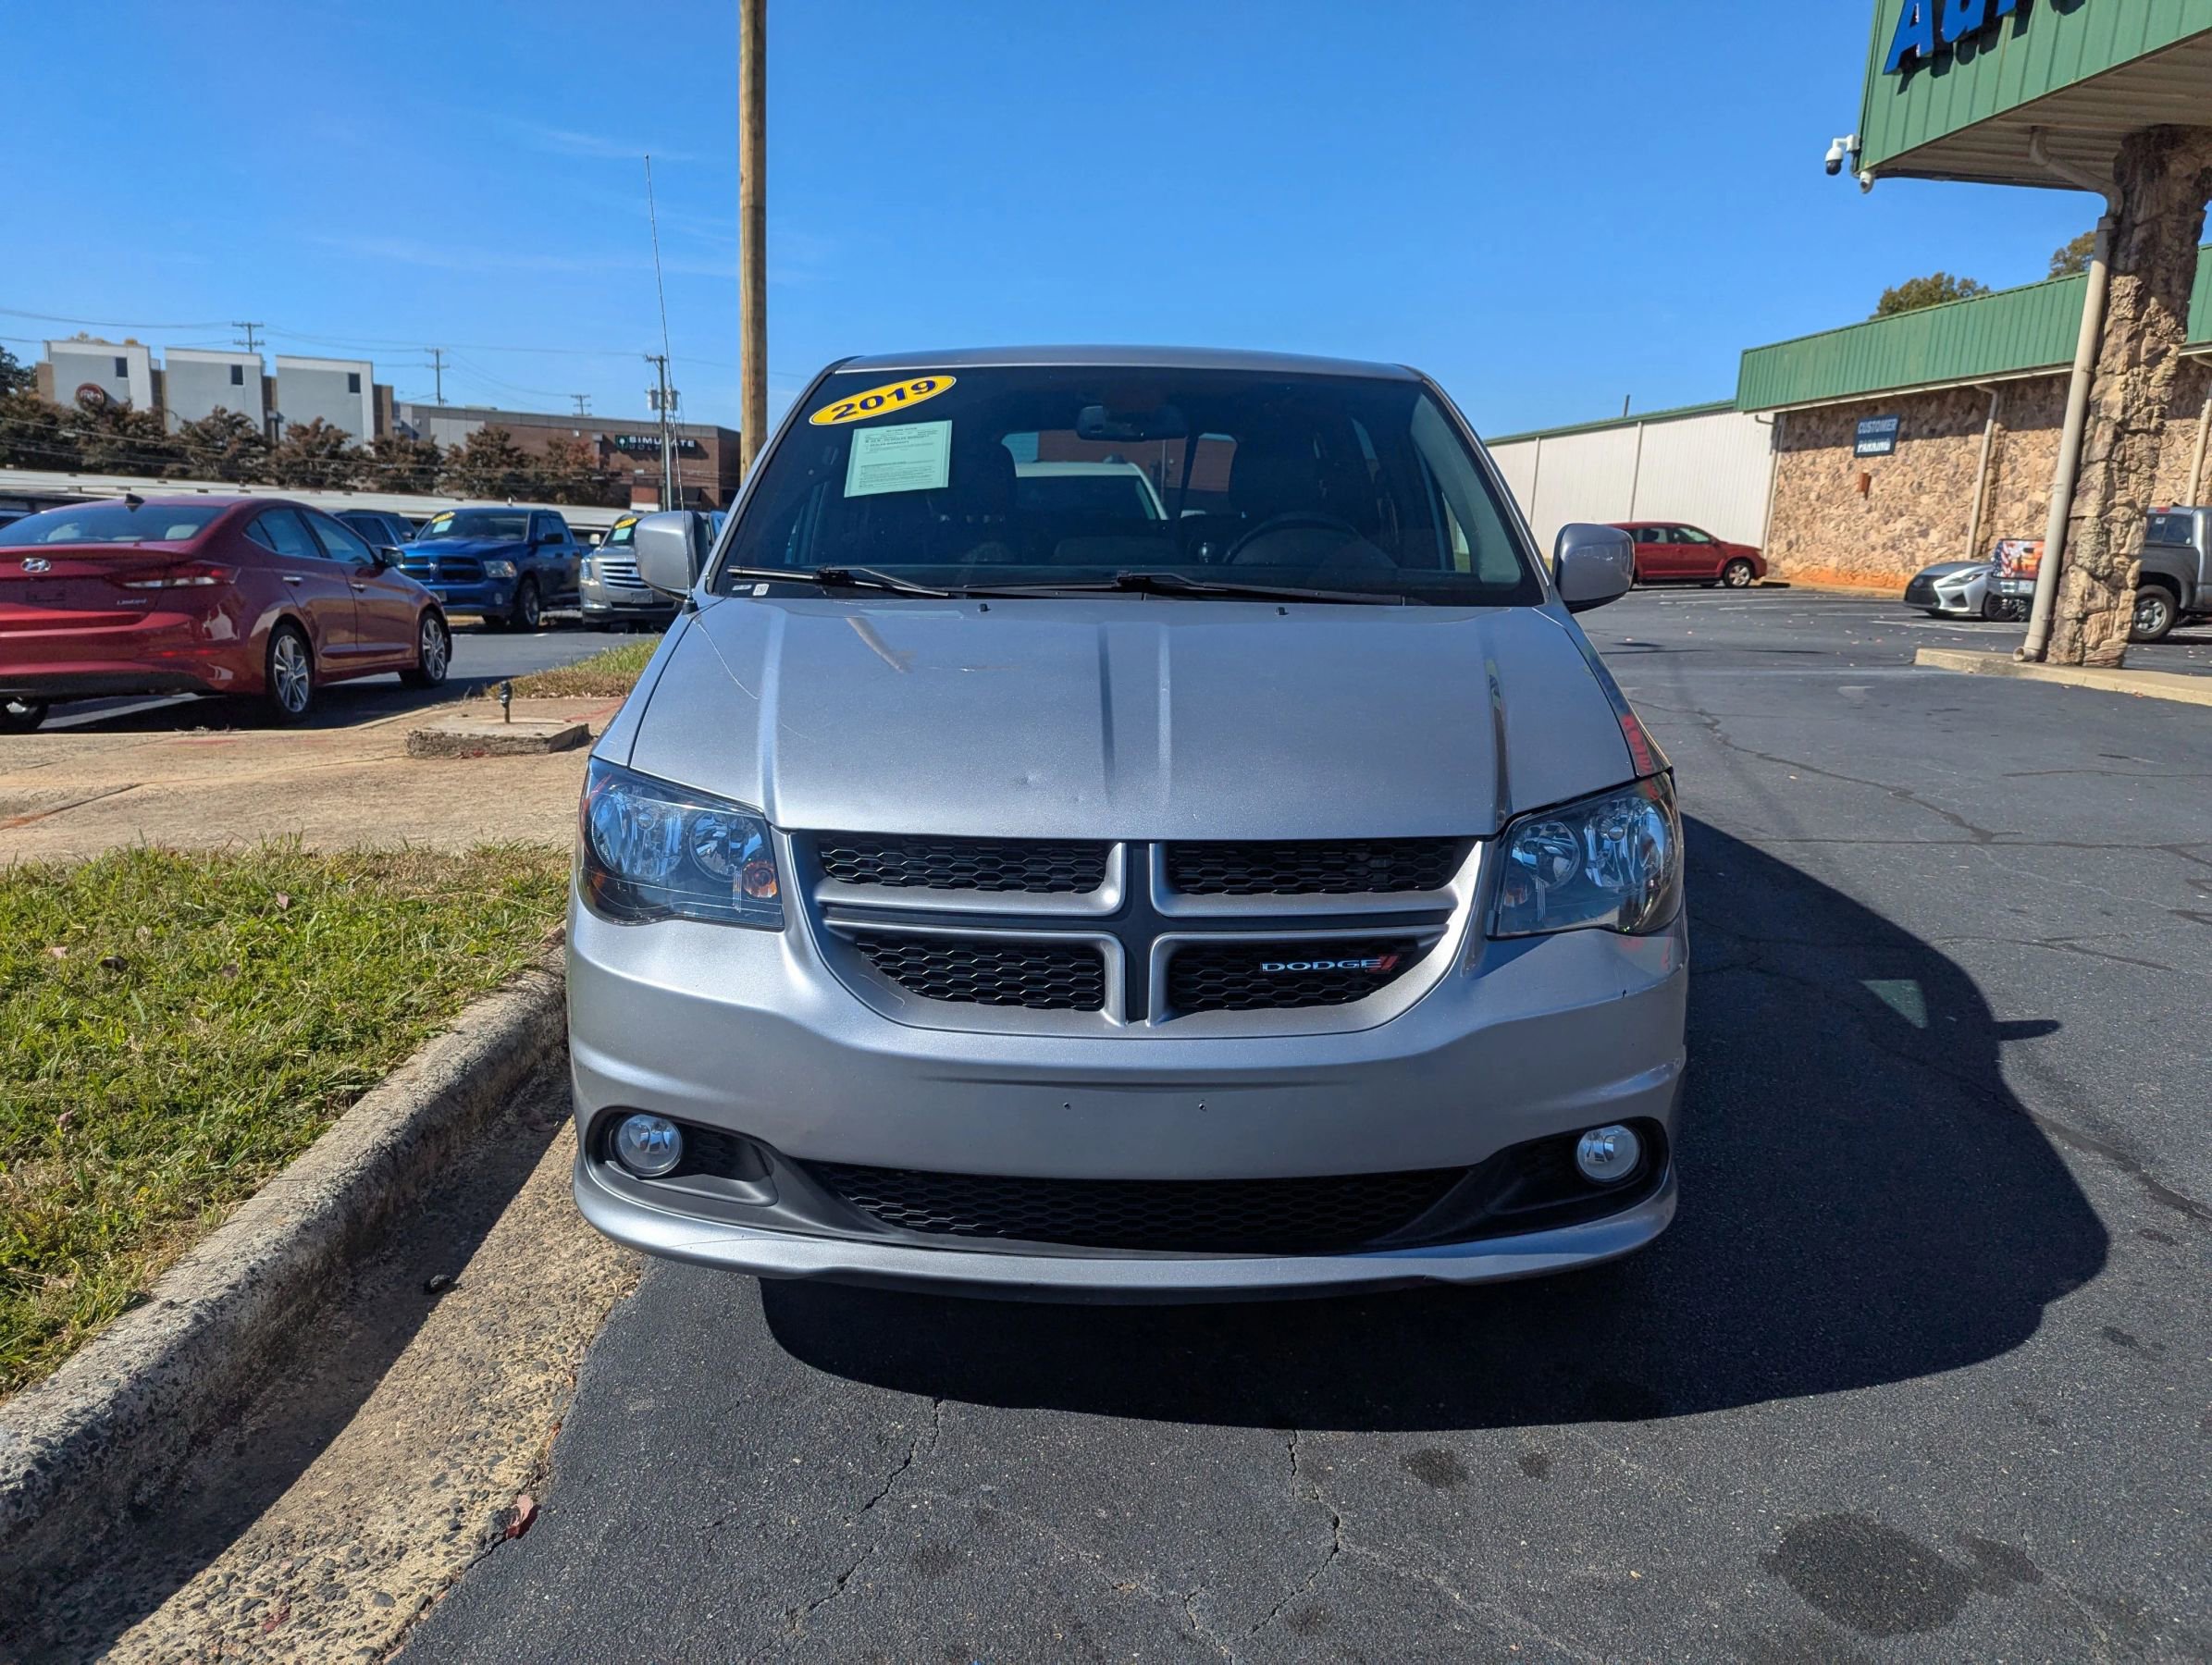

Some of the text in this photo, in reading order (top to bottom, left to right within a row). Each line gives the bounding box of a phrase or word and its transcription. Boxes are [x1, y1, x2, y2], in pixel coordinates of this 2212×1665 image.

[832, 379, 937, 421] 2019
[1858, 418, 1897, 435] CUSTOMER
[1857, 438, 1891, 453] PARKING
[1262, 959, 1381, 971] DODGE
